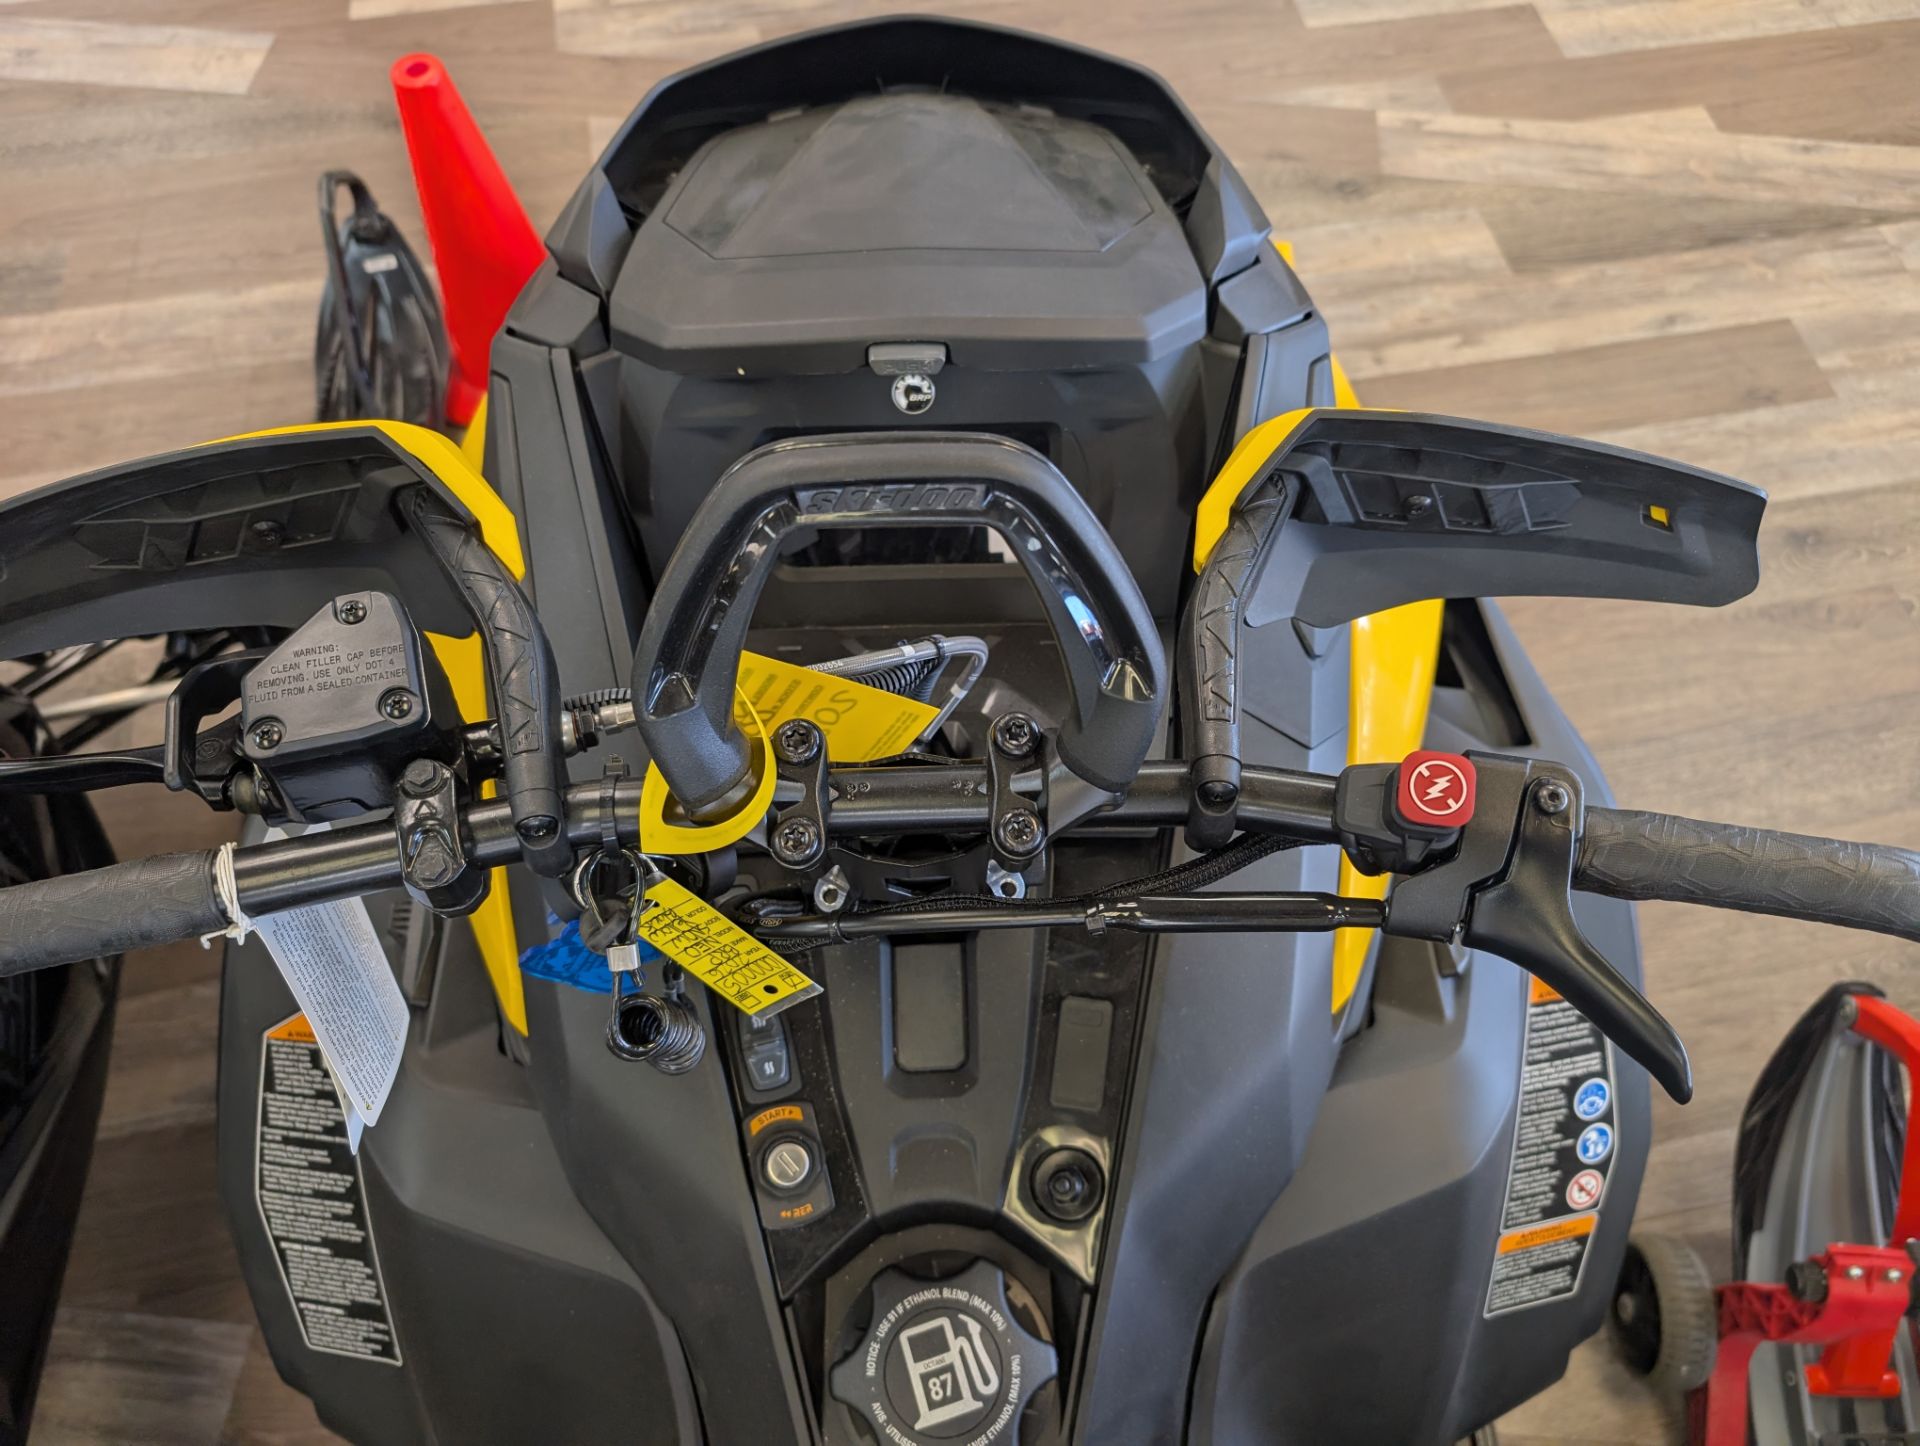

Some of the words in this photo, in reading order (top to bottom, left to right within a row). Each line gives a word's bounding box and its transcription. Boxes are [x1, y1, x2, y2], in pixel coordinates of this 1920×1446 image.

[909, 394, 932, 402] BRP
[270, 663, 300, 675] CLEAN
[306, 654, 341, 668] FILLER
[347, 652, 364, 662] CAP
[370, 643, 404, 658] BEFORE
[293, 643, 339, 658] WARNING:
[257, 673, 309, 690] REMOVING.
[313, 670, 331, 680] USE
[337, 664, 360, 676] ONLY
[365, 660, 383, 670] DOT
[388, 658, 394, 667] 4
[248, 691, 278, 703] FLUID
[281, 686, 306, 698] FROM
[307, 683, 314, 693] A
[317, 677, 352, 691] SEALED
[355, 667, 408, 684] CONTAINER
[684, 906, 707, 916] COLOR
[712, 926, 734, 936] MODEL
[729, 936, 748, 945] MAKE
[743, 946, 761, 955] YEAR
[758, 1108, 786, 1126] START
[866, 1341, 880, 1376] NOTICE
[876, 1318, 891, 1337] USE
[887, 1309, 898, 1322] 91
[896, 1303, 904, 1315] IF
[903, 1288, 941, 1309] ETHANOL
[943, 1287, 969, 1301] BLEND
[969, 1294, 992, 1315] (MAX
[923, 1356, 946, 1370] OCTANE
[1010, 1354, 1021, 1375] 10%)
[928, 1371, 952, 1401] 87
[1008, 1377, 1020, 1403] (MAX
[871, 1402, 887, 1423] AVIS
[986, 1403, 1015, 1440] ETHANOL
